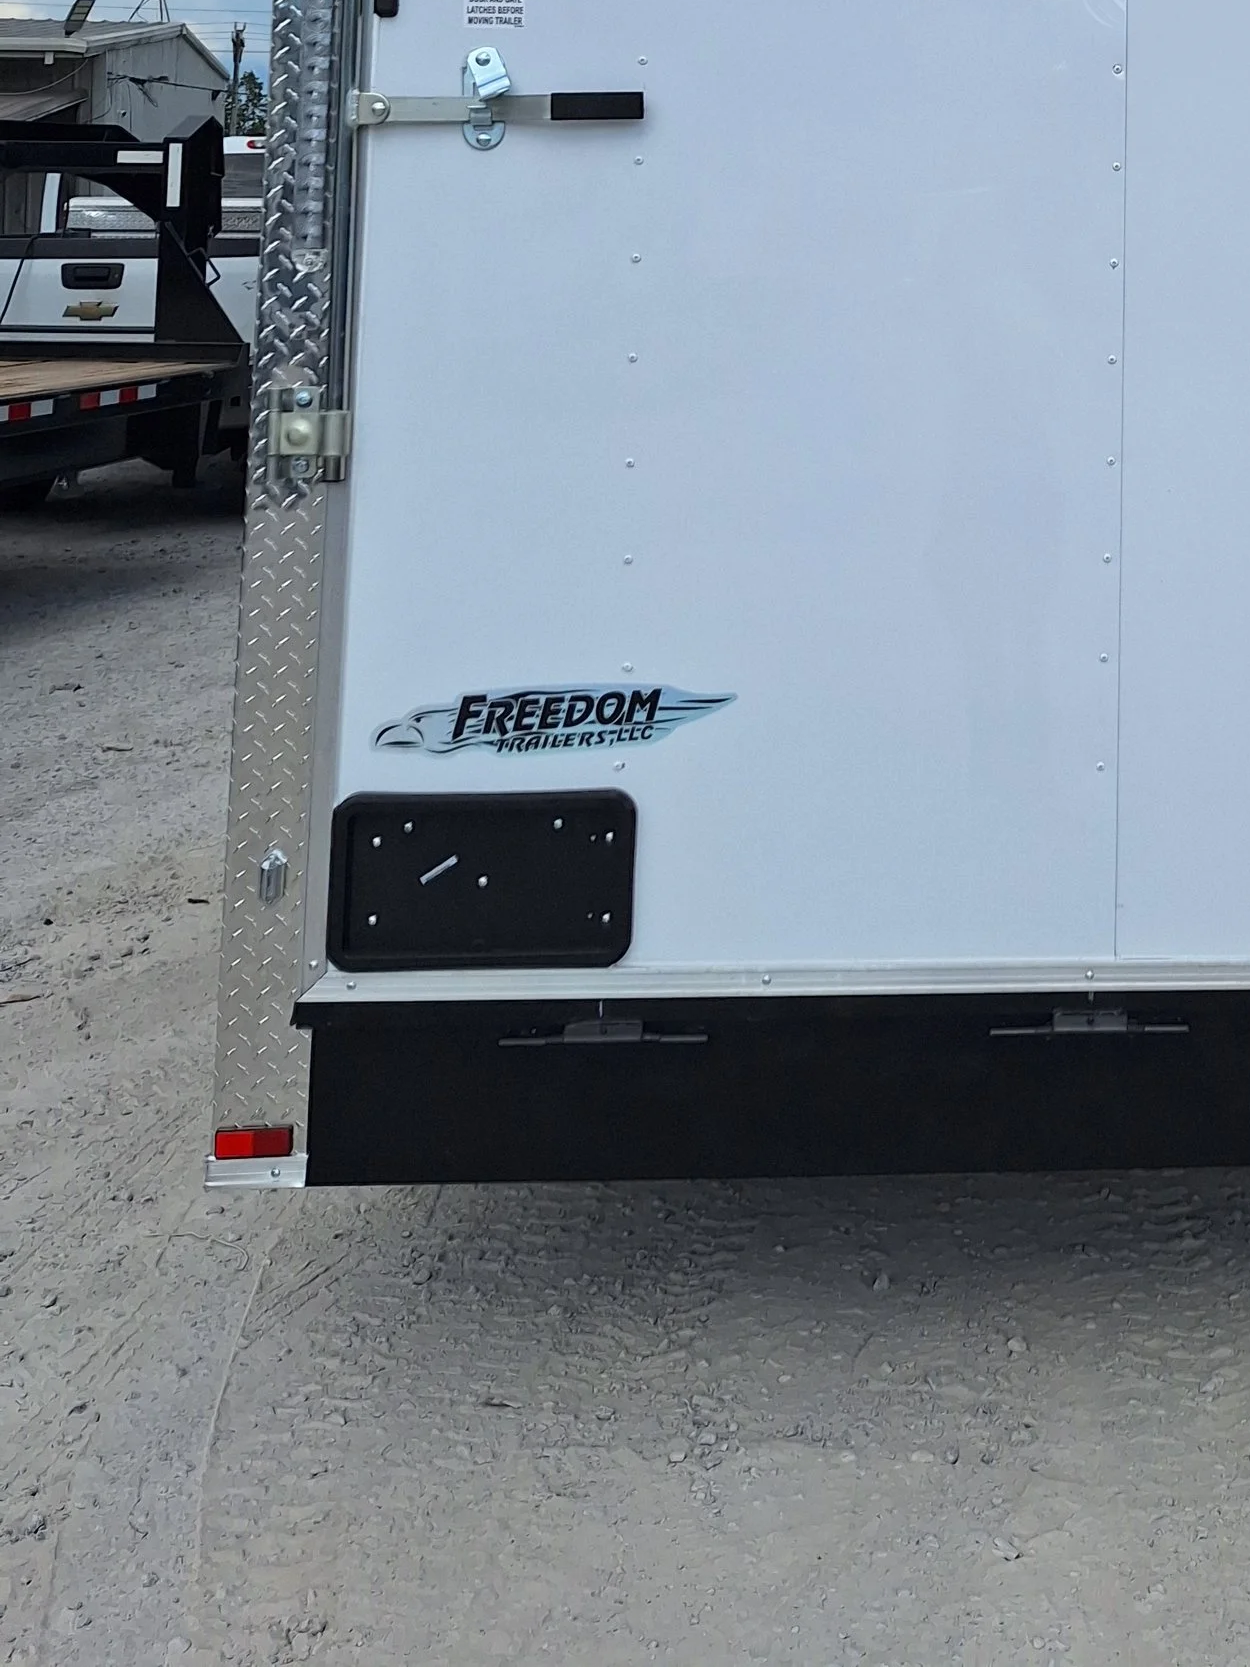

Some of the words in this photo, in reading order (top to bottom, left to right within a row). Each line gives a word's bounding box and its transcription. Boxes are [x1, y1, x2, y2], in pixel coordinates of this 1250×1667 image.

[467, 6, 497, 14] LATCHES
[498, 6, 524, 14] BEFORE
[468, 16, 494, 25] MOVING
[495, 16, 523, 25] TRAILER
[451, 688, 663, 741] FREEDOM
